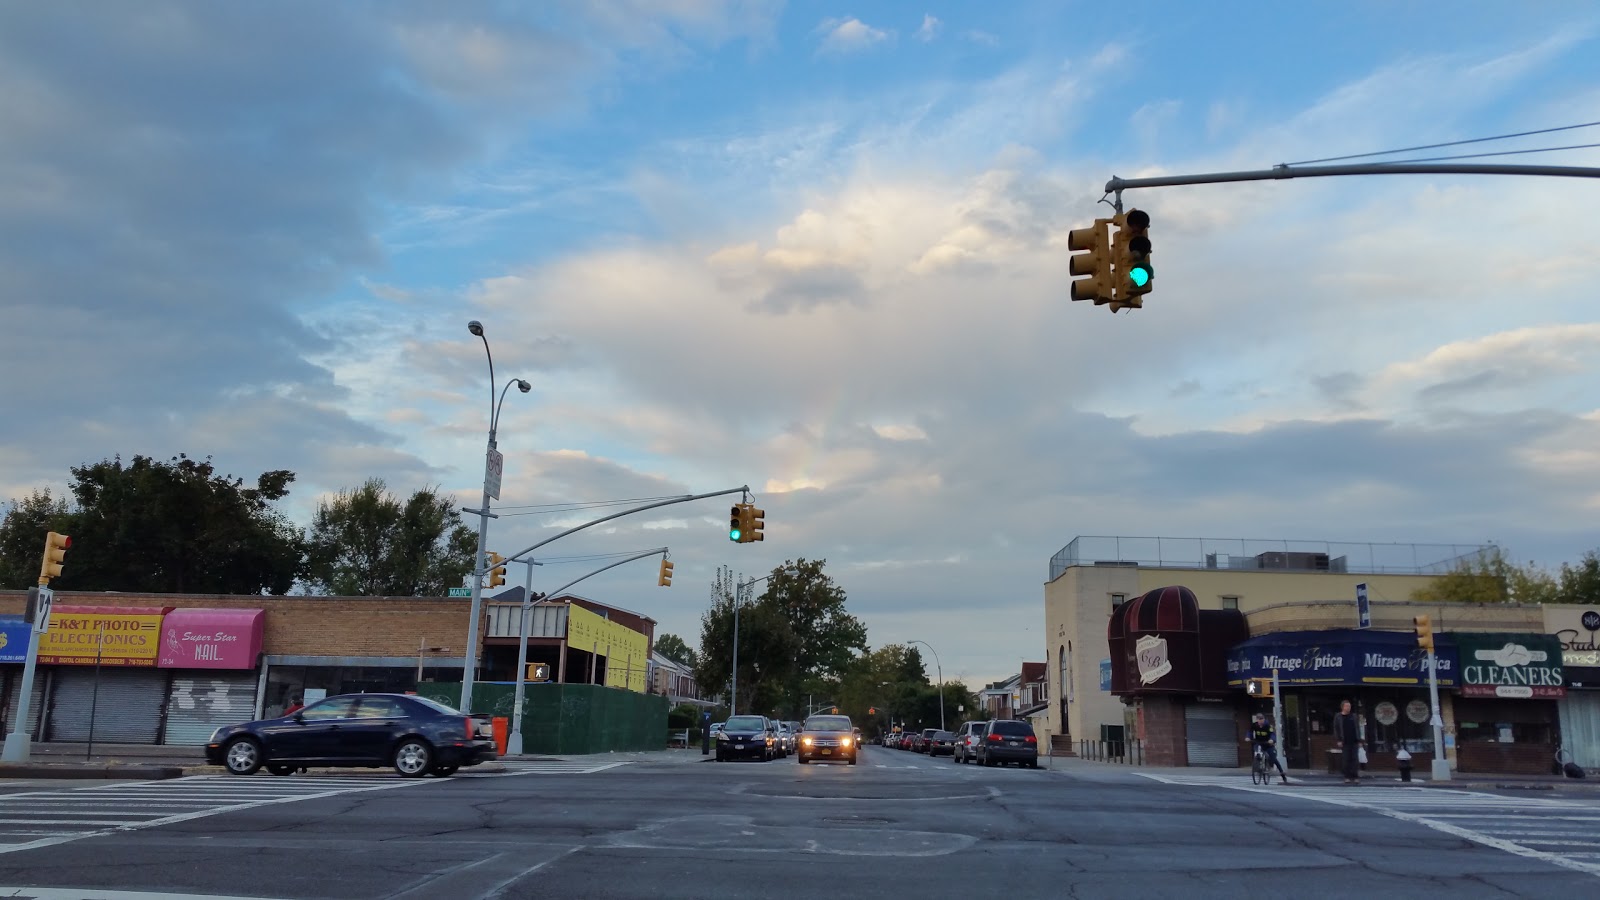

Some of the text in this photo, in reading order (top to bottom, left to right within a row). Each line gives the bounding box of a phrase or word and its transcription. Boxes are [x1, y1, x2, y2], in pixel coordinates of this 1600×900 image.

[59, 619, 141, 631] K&T PHOTO
[49, 632, 147, 646] ELECTRONICS
[182, 631, 237, 642] Super Star
[194, 643, 219, 661] NAIL
[1262, 655, 1302, 671] Mirage
[1363, 653, 1407, 671] Mirage
[1464, 665, 1563, 686] CLEANERS
